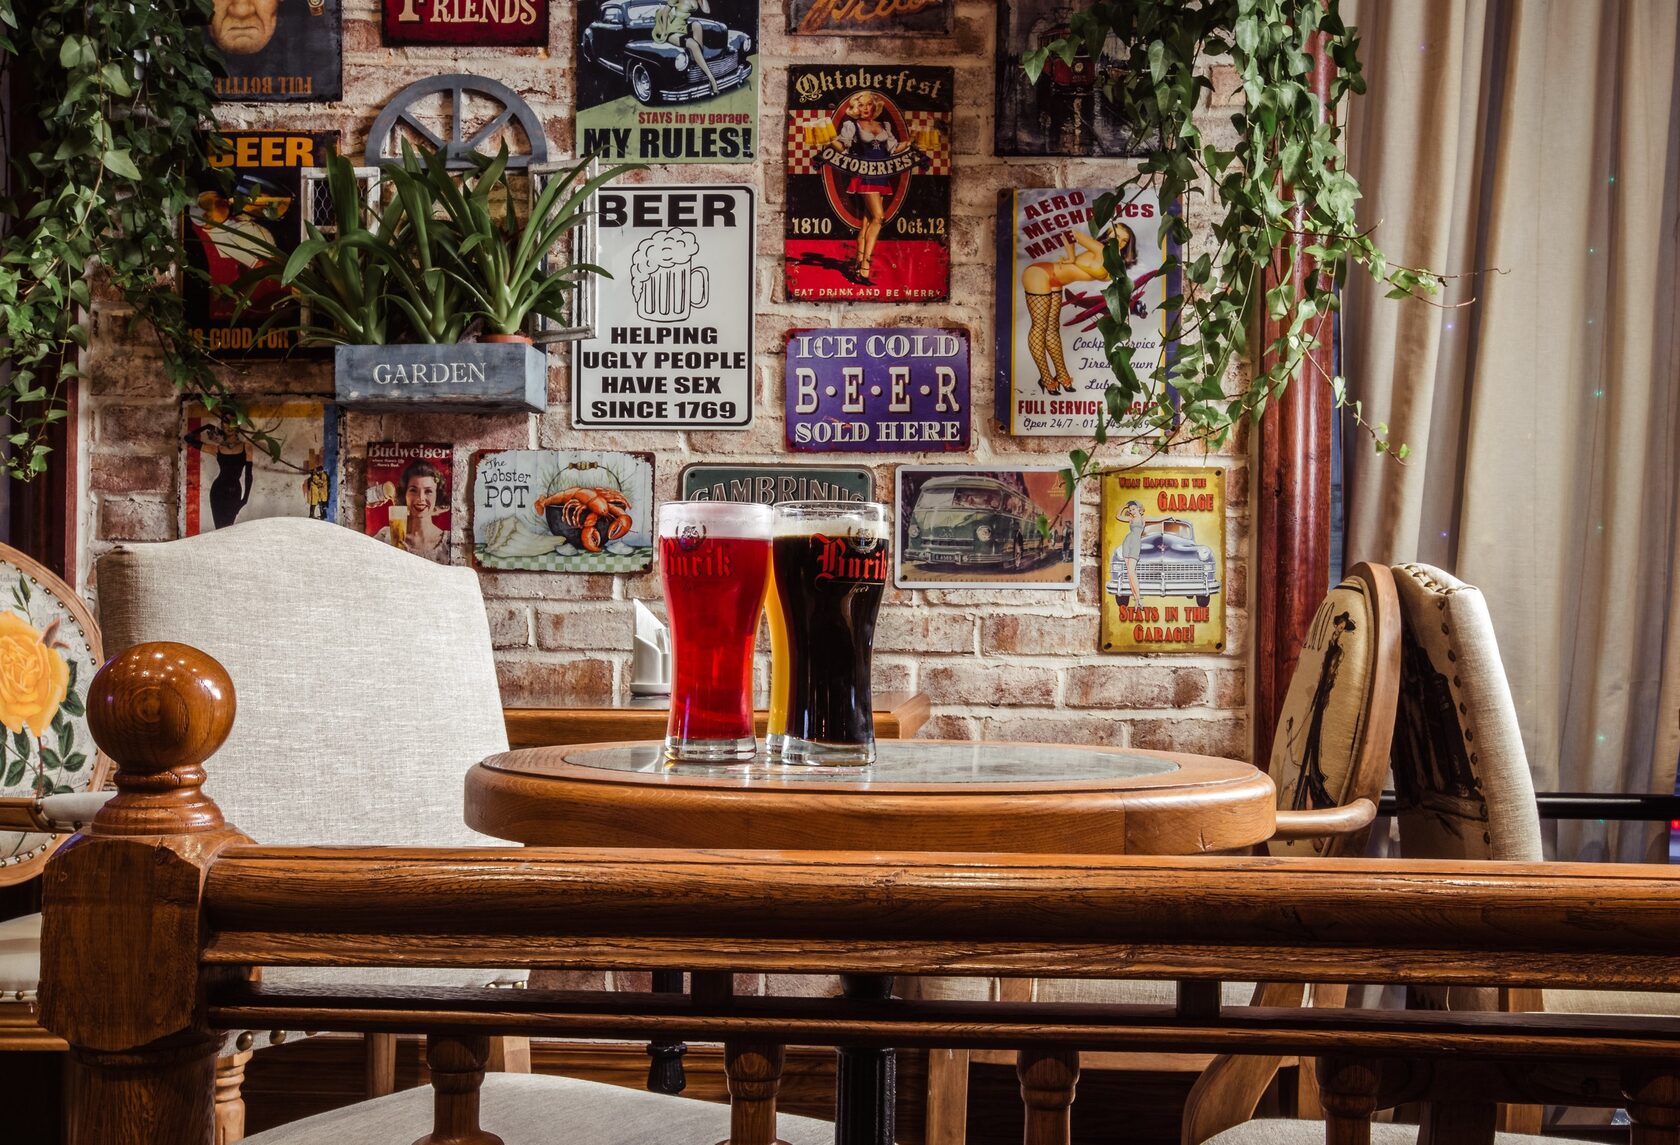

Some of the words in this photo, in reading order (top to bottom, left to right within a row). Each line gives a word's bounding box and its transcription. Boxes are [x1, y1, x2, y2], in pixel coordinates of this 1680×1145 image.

[279, 76, 312, 96] FULL
[795, 68, 942, 103] Oktoberfest
[638, 111, 673, 125] STAYS
[675, 111, 686, 124] in
[688, 113, 706, 125] my
[708, 113, 753, 126] garage.
[583, 128, 632, 159] MY
[639, 127, 754, 159] RULES!
[822, 147, 921, 176] OKTOBERFEST
[598, 194, 737, 228] BEER
[1024, 191, 1086, 220] AERO
[792, 217, 832, 235] 1810
[896, 217, 945, 234] Oct.12
[1022, 203, 1154, 240] MECHAICS
[1024, 229, 1078, 260] MATE
[794, 288, 814, 297] EAT
[819, 288, 853, 297] DRINK
[858, 288, 881, 297] AND
[885, 288, 900, 297] BE
[904, 289, 941, 297] MERRY
[209, 327, 252, 350] GOOD
[611, 327, 718, 345] HELPING
[1120, 337, 1156, 349] ervice
[795, 335, 858, 359] ICE
[865, 335, 960, 358] COLD
[583, 351, 648, 369] UGLY
[654, 351, 746, 369] PEOPLE
[1079, 357, 1111, 370] Tires
[372, 362, 487, 385] GARDEN
[601, 376, 668, 394] HAVE
[674, 376, 722, 394] SEX
[1084, 379, 1110, 390] Lub
[591, 401, 668, 419] SINCE
[674, 401, 737, 419] 1769
[1018, 400, 1046, 415] FULL
[795, 422, 870, 443] SOLD
[876, 421, 960, 442] HERE
[1023, 417, 1048, 430] Open
[1050, 418, 1073, 429] 24/7
[368, 443, 450, 459] Budweiser
[485, 457, 506, 470] The
[481, 466, 532, 484] Lobster
[1143, 477, 1178, 488] HAPPENS
[1181, 478, 1190, 488] IN
[1192, 478, 1207, 488] THE
[484, 485, 530, 508] POT
[1157, 490, 1214, 511] GARAGE
[1119, 605, 1160, 622] STAYS
[1165, 606, 1178, 622] IN
[1184, 606, 1210, 622] THE
[1133, 624, 1195, 643] GARAGE!
